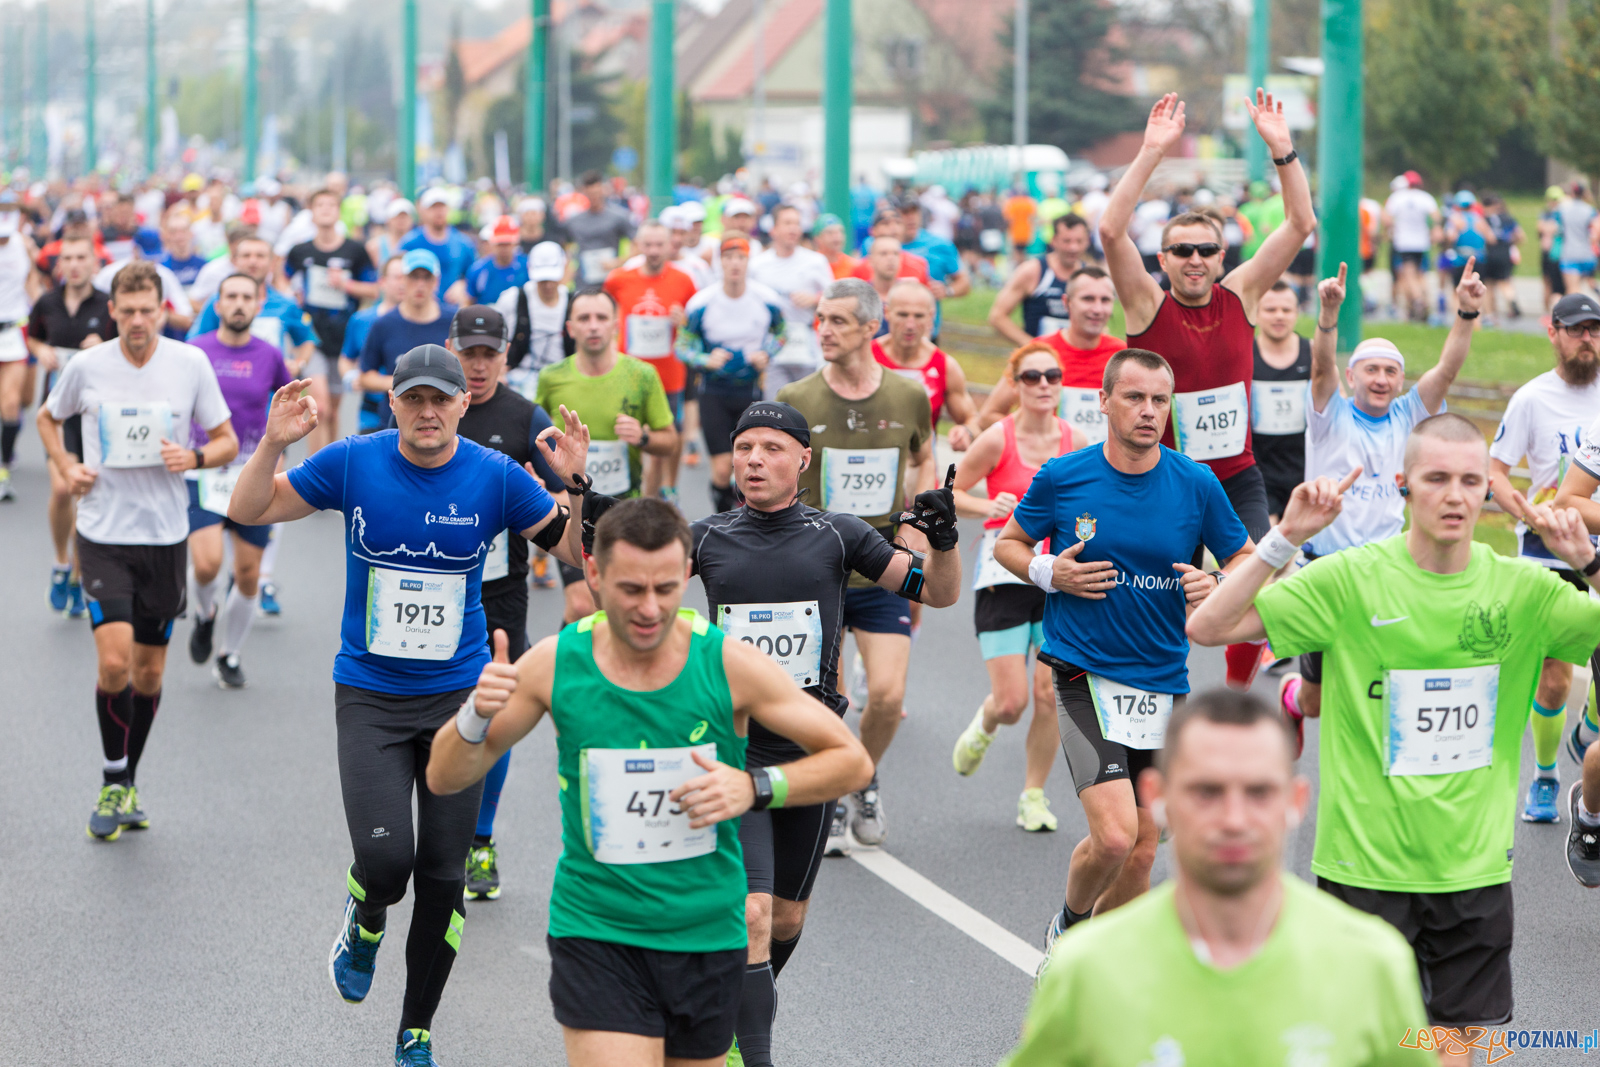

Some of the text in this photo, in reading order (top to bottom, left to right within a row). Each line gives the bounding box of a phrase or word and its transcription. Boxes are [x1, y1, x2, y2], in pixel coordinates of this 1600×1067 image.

[749, 409, 782, 419] FALKE
[1195, 409, 1238, 431] 4187
[126, 425, 150, 440] 49
[841, 472, 886, 490] 7399
[393, 602, 445, 627] 1913
[405, 625, 431, 634] Dariusz
[1112, 694, 1158, 716] 1765
[1416, 703, 1479, 733] 5710
[1434, 733, 1465, 742] Damian
